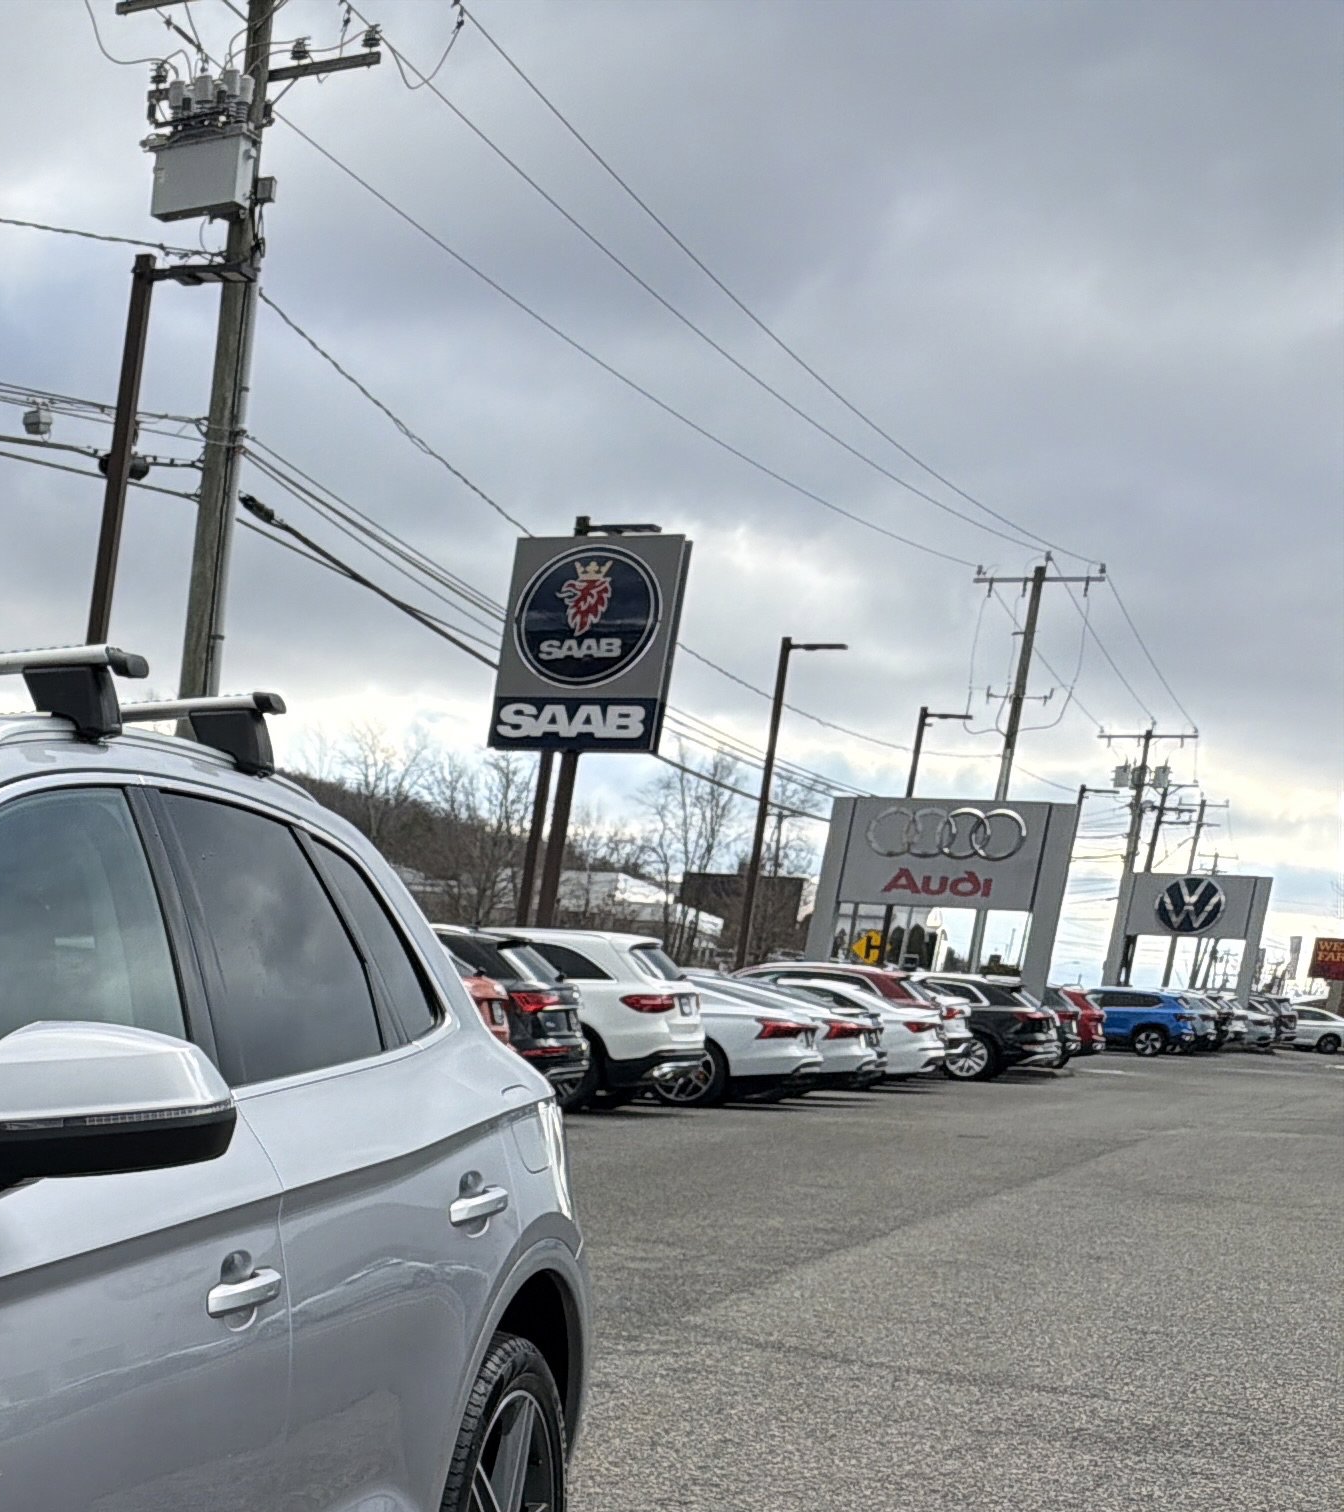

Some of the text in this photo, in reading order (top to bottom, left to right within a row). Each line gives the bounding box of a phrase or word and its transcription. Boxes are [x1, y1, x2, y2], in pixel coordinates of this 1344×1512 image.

[538, 637, 622, 660] SAAB
[496, 702, 646, 738] SAAB
[881, 867, 993, 898] Audi
[1318, 941, 1344, 952] WE
